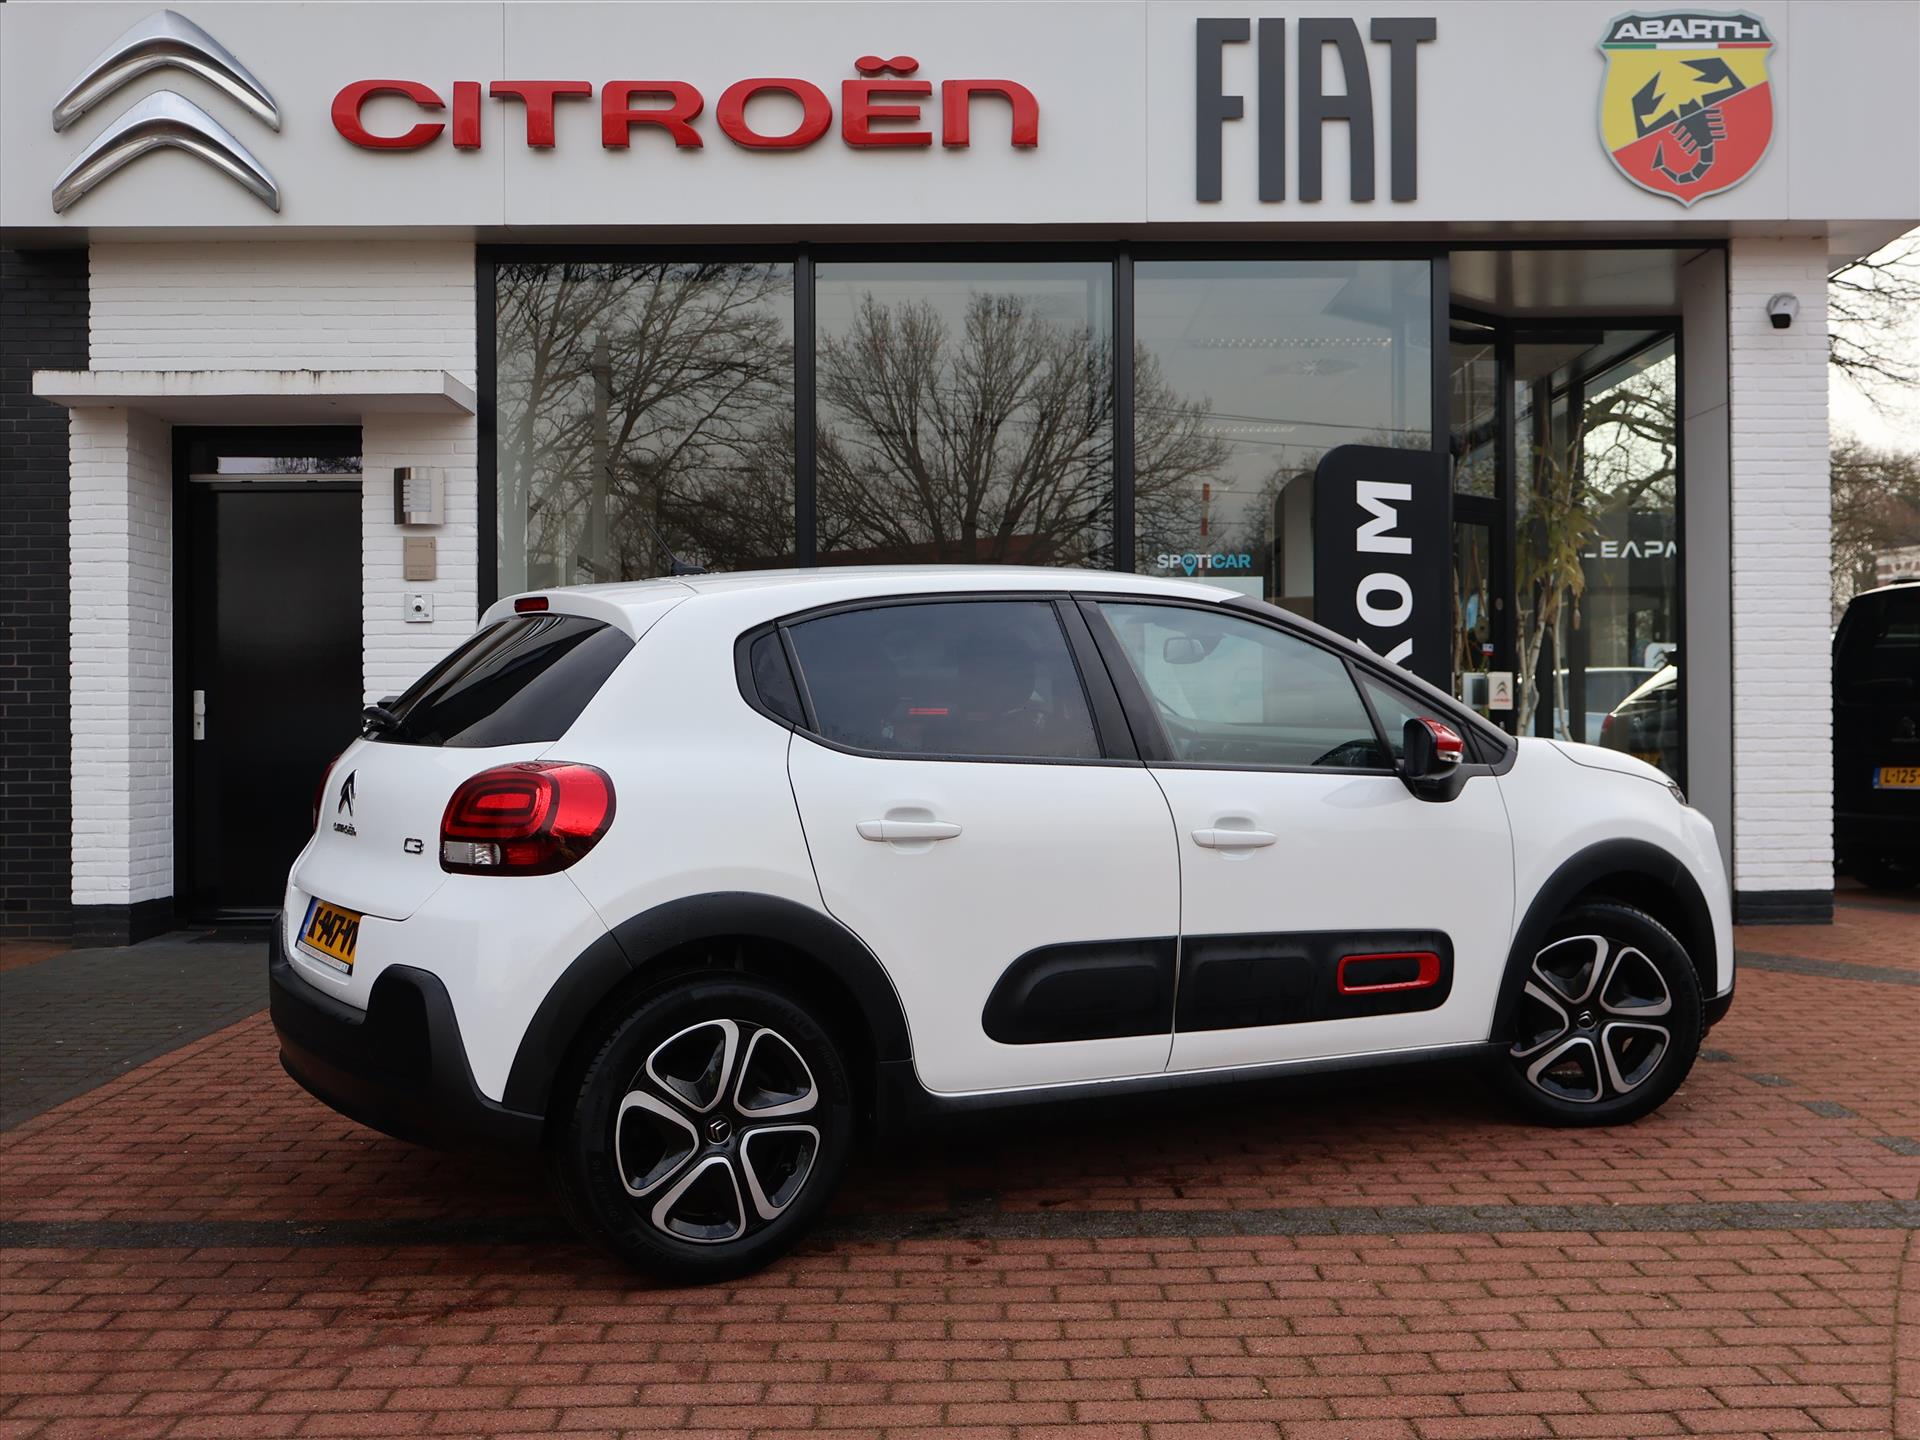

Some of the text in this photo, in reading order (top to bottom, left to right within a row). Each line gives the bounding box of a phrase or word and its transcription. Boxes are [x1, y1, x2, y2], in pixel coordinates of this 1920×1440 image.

[1613, 18, 1761, 40] ABARTH
[331, 55, 1039, 151] CITROËN
[1195, 17, 1437, 204] FIAT
[404, 837, 424, 856] C3
